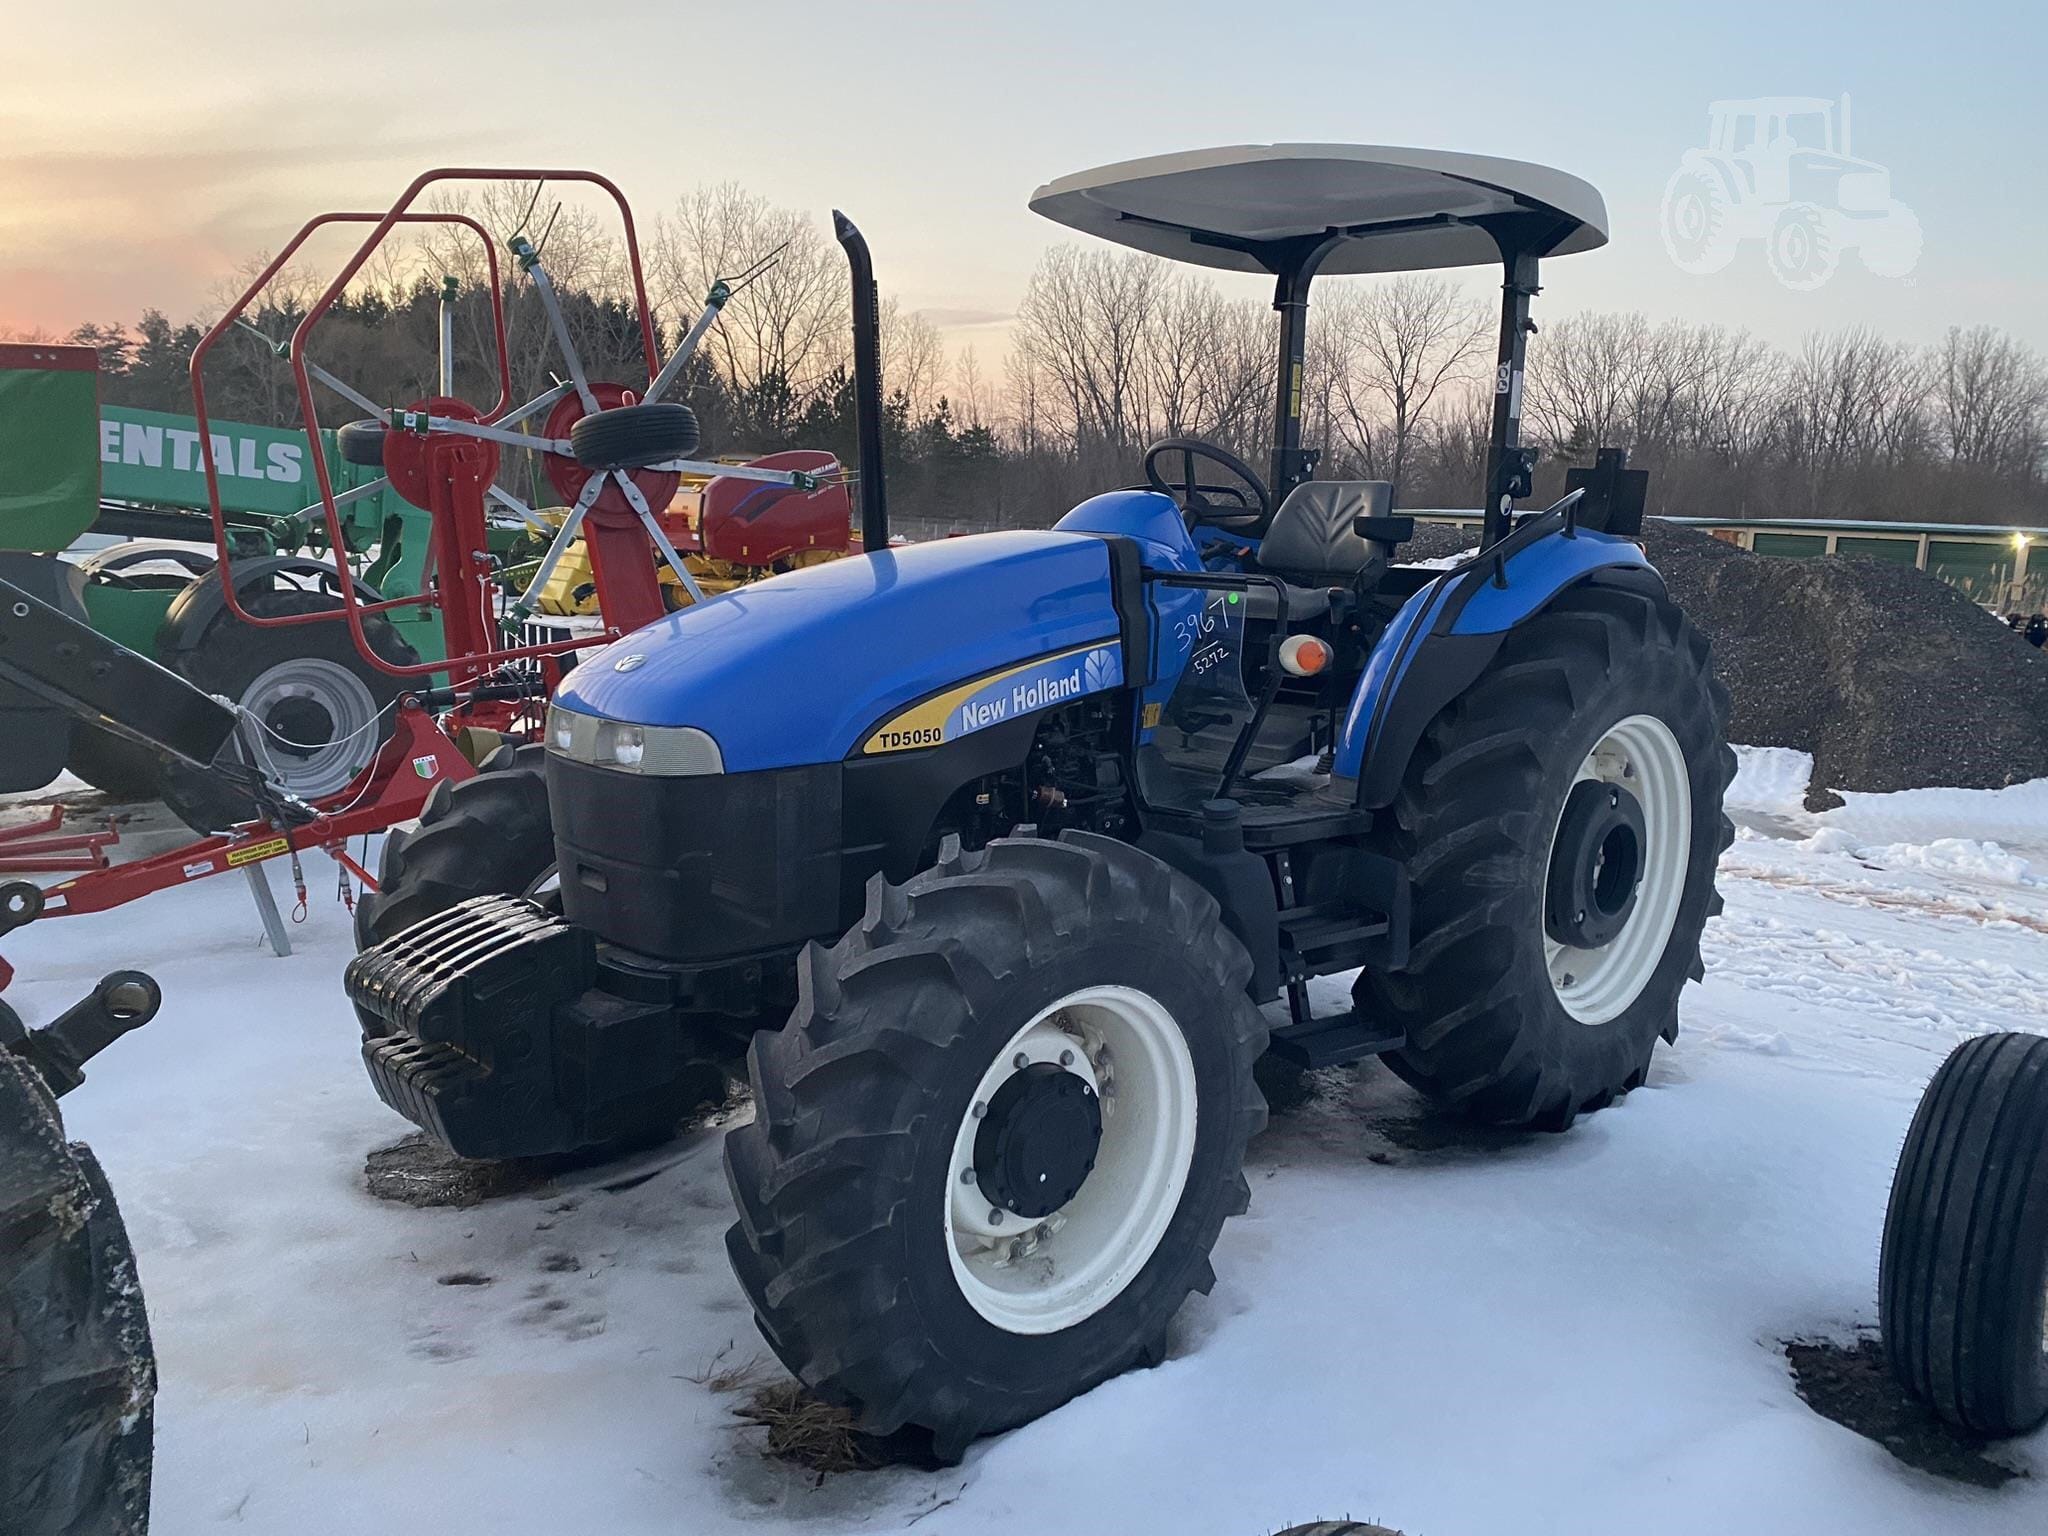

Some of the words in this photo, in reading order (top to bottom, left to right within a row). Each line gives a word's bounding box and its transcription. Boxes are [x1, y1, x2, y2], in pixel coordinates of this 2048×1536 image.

[1174, 597, 1229, 652] 3967
[1194, 648, 1229, 674] 5272
[961, 698, 1006, 731] New
[1013, 669, 1080, 713] Holland
[880, 728, 941, 748] TD5050
